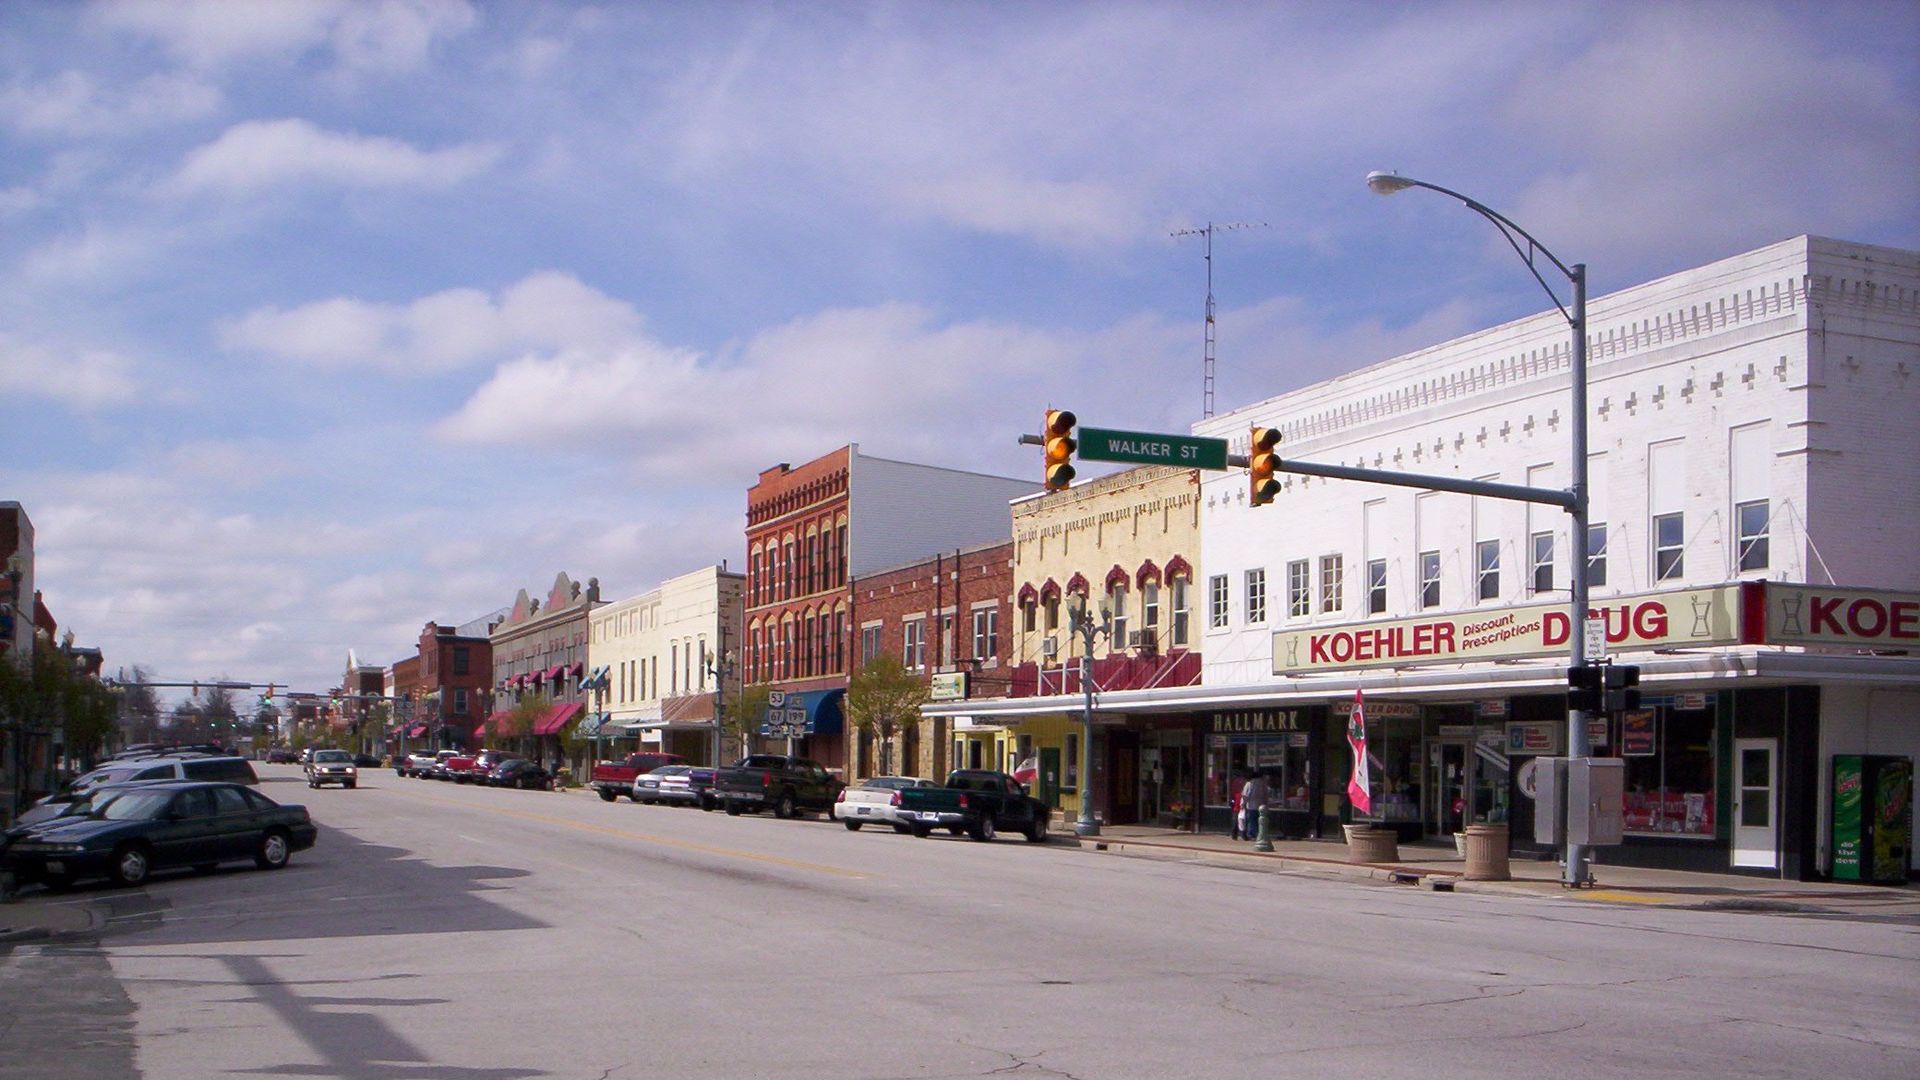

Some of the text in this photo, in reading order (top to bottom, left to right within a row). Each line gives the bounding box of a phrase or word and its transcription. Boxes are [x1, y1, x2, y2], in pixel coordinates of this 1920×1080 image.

[1108, 439, 1199, 458] WALKER ST
[1463, 613, 1515, 637] Discount
[1810, 596, 1920, 639] KOE
[1310, 621, 1456, 664] KOEHLER
[1462, 621, 1541, 650] Prescriptions
[771, 692, 783, 703] 53
[771, 711, 782, 721] 67
[788, 711, 804, 721] 199
[1213, 711, 1298, 732] HALLMARK
